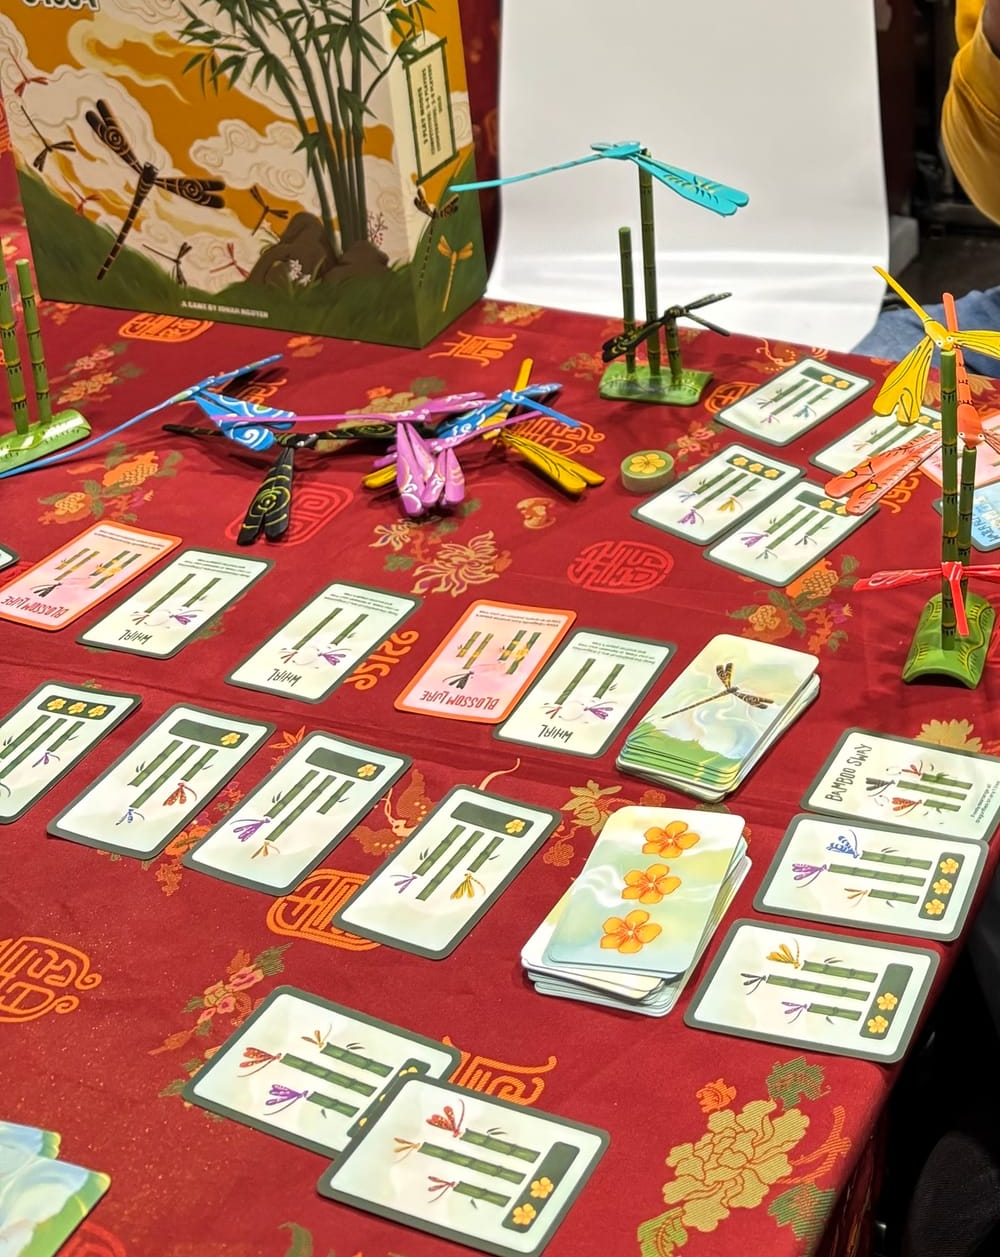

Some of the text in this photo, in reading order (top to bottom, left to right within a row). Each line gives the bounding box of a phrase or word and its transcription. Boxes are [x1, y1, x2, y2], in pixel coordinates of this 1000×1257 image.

[1, 595, 70, 619] BLOSSOM LURE
[118, 629, 153, 645] WHIRL
[266, 668, 302, 687] WHIRL
[419, 690, 500, 711] BLOSSOM LURE
[538, 724, 574, 743] WHIRL
[825, 744, 873, 803] BAMBOO SWAY
